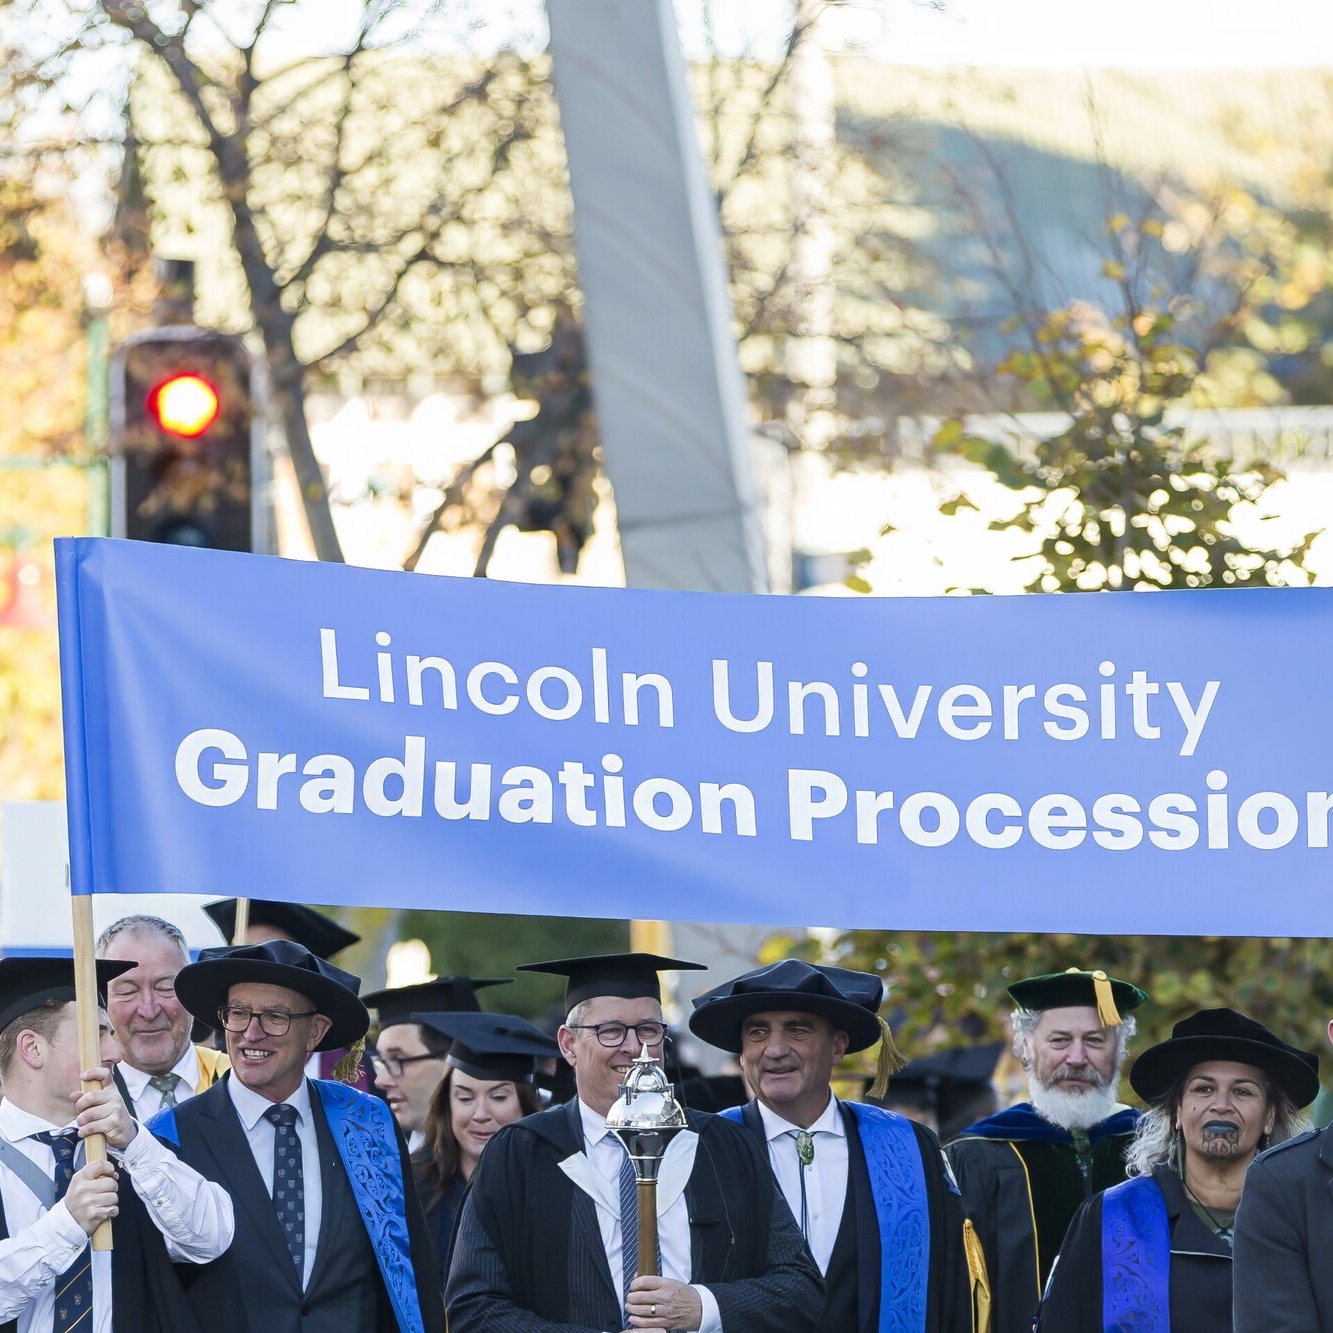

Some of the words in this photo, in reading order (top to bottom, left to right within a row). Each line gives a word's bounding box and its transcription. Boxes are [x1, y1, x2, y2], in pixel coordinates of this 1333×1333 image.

[320, 628, 674, 728] Lincoln
[712, 659, 1221, 757] University
[175, 728, 757, 837] Graduation
